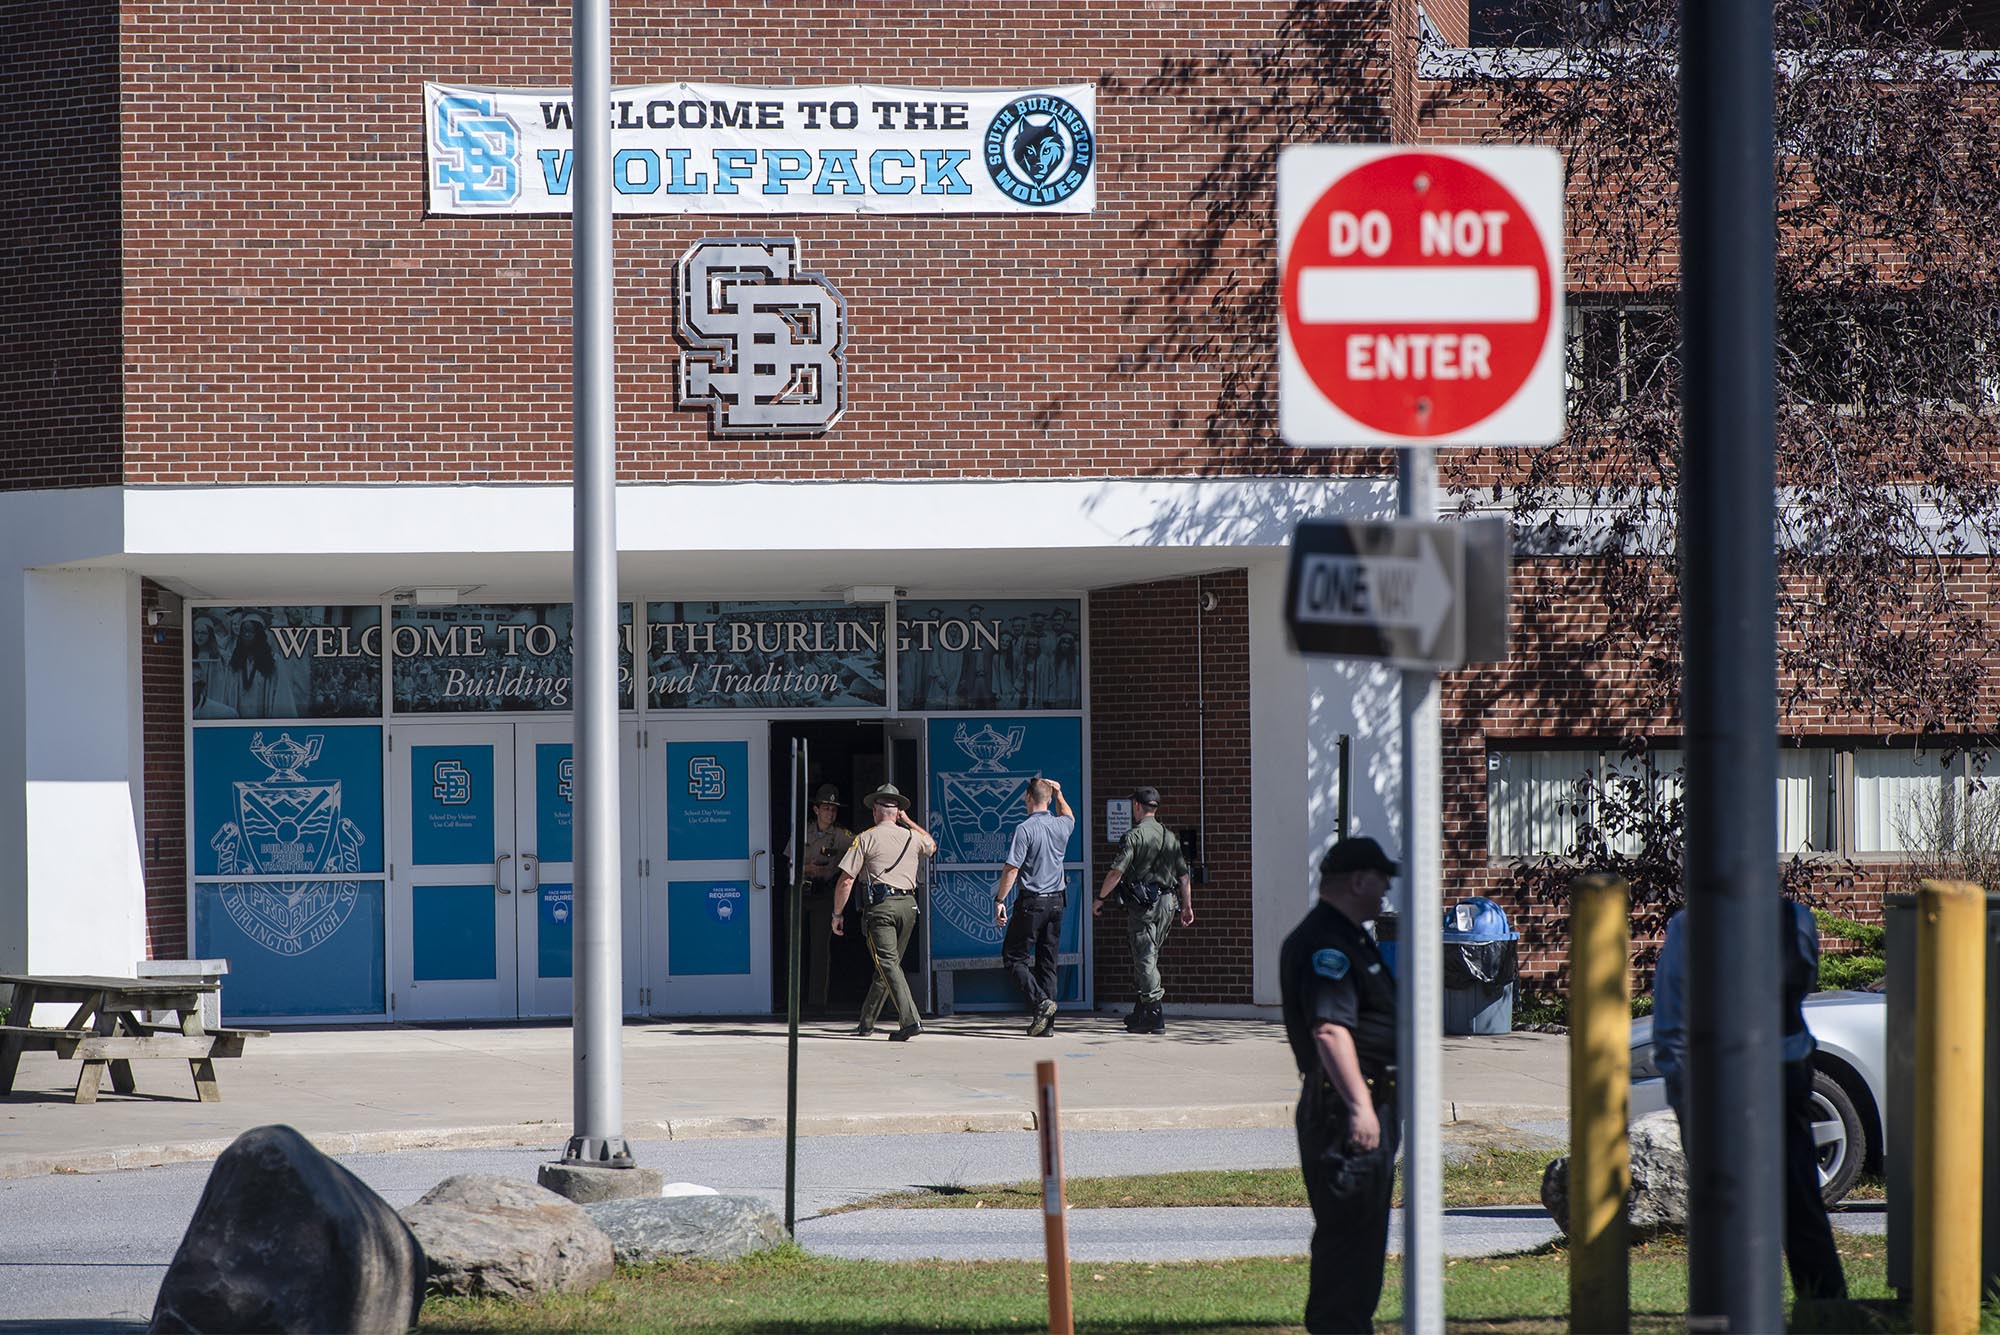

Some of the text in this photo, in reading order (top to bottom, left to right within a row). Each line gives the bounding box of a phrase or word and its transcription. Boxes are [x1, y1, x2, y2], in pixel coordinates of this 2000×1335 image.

[539, 100, 969, 130] WLCOME TO THE
[988, 98, 1089, 166] SOUTH BURLINGTON
[996, 168, 1083, 203] WOLVES
[1328, 208, 1511, 258] DO NOT
[679, 237, 848, 433] SB
[1345, 332, 1492, 381] ENTER
[1307, 563, 1368, 616] ONE
[270, 619, 1002, 658] WELCOME TO UTH BURLINGTON
[442, 665, 571, 706] Building
[707, 660, 838, 694] Tradition
[433, 760, 471, 805] SB
[689, 756, 725, 801] SB
[684, 808, 701, 816] School
[260, 842, 315, 853] BUILDING A
[262, 861, 313, 872] TRADITION
[272, 852, 304, 862] PROUD
[250, 884, 329, 929] PROBITY
[709, 891, 741, 899] REQUIRED
[227, 895, 302, 954] BURLINGTON
[310, 910, 341, 945] HIGH
